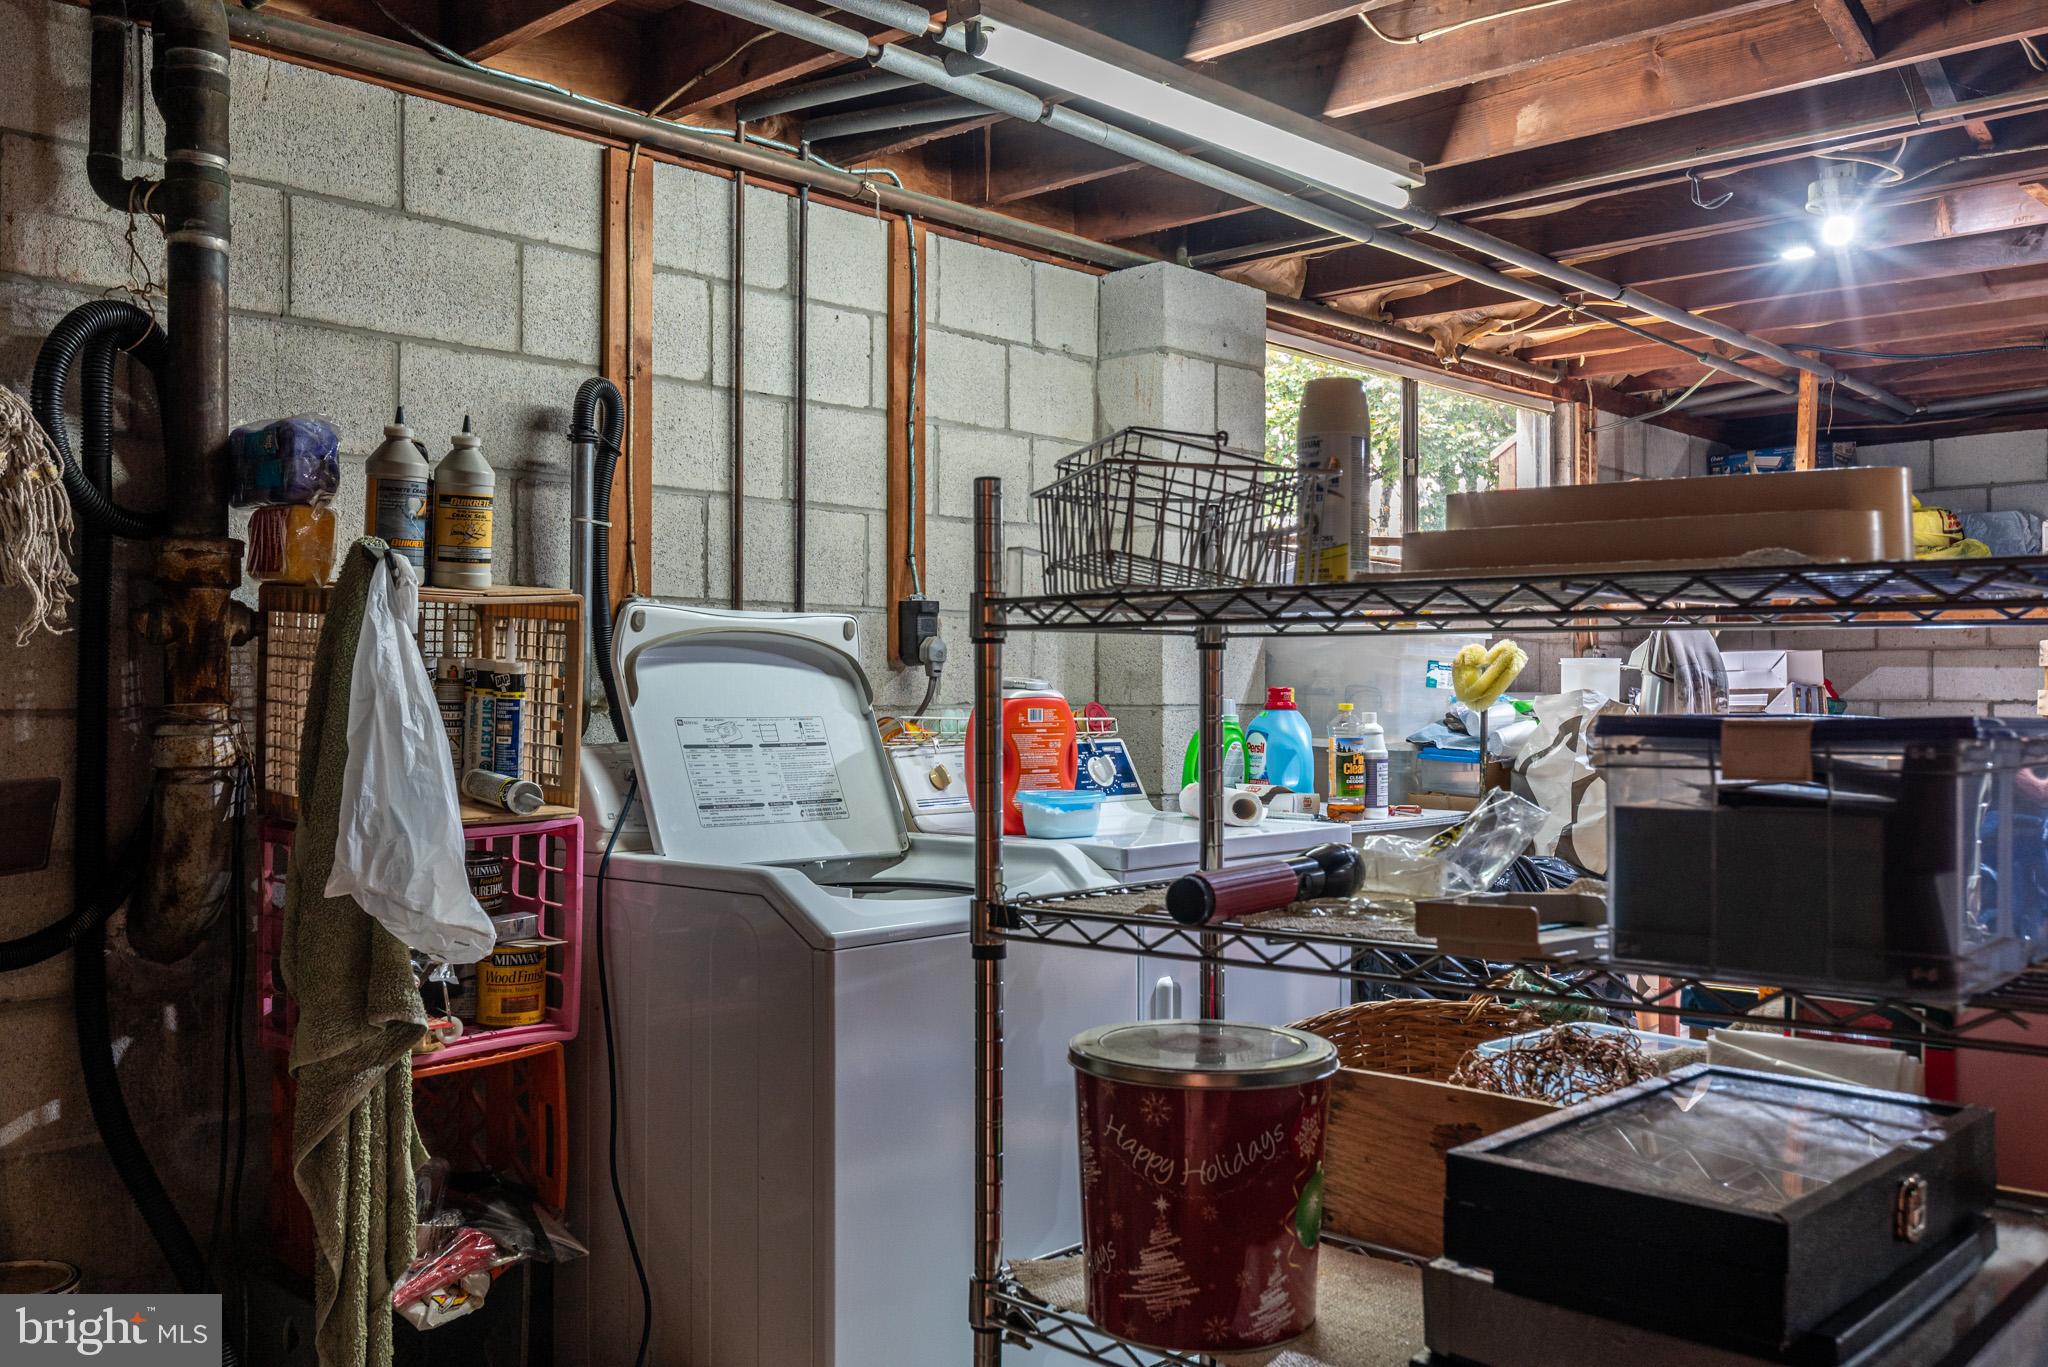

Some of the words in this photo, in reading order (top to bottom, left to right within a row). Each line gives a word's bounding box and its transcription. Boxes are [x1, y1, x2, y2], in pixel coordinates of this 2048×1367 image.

[450, 497, 492, 507] QUIKRETE
[451, 511, 472, 519] CRACK
[496, 674, 510, 686] DAP
[481, 699, 494, 728] PLUS
[480, 730, 493, 758] ALEX
[1246, 741, 1265, 754] Persil
[1343, 762, 1365, 775] Clea
[486, 969, 518, 984] Wood
[1103, 1114, 1175, 1185] Happy
[1180, 1123, 1285, 1186] Holidays
